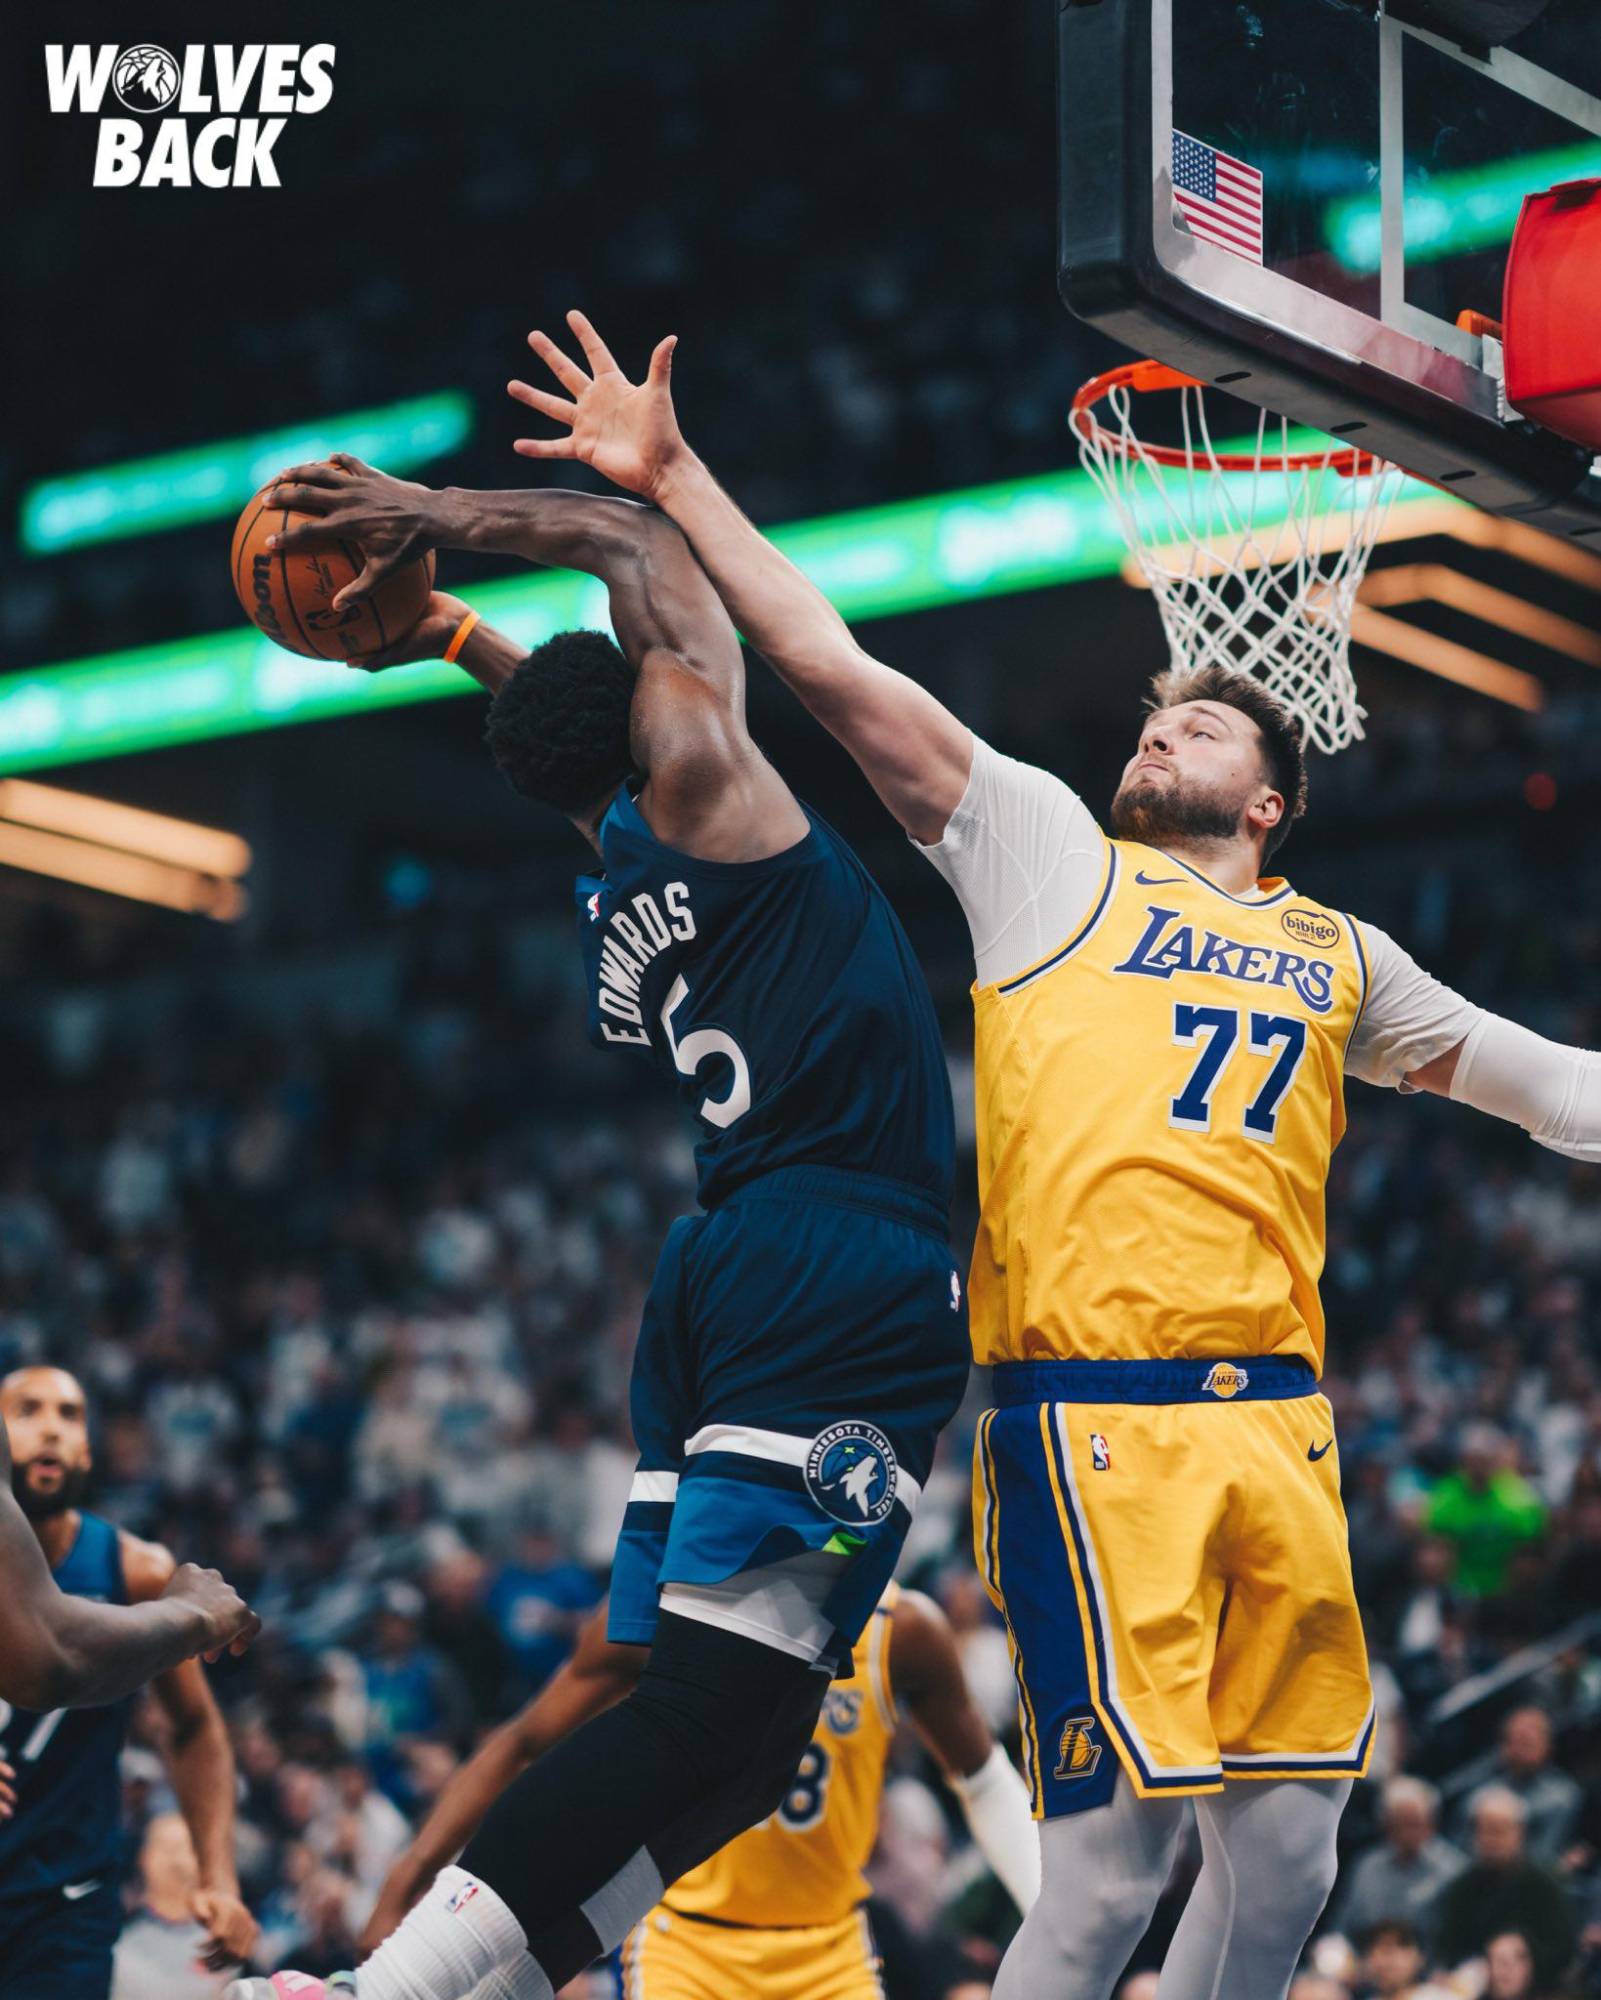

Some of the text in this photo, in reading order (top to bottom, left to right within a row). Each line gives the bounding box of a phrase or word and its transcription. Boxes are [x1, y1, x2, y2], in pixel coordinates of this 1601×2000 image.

[599, 881, 697, 1046] EDWARDS
[1113, 905, 1334, 1014] LAKERS
[1286, 915, 1336, 940] bibigo
[660, 973, 751, 1129] 5
[1168, 1001, 1308, 1145] 77
[1204, 1371, 1247, 1390] LAKERS
[808, 1425, 861, 1479] MINNESOTA
